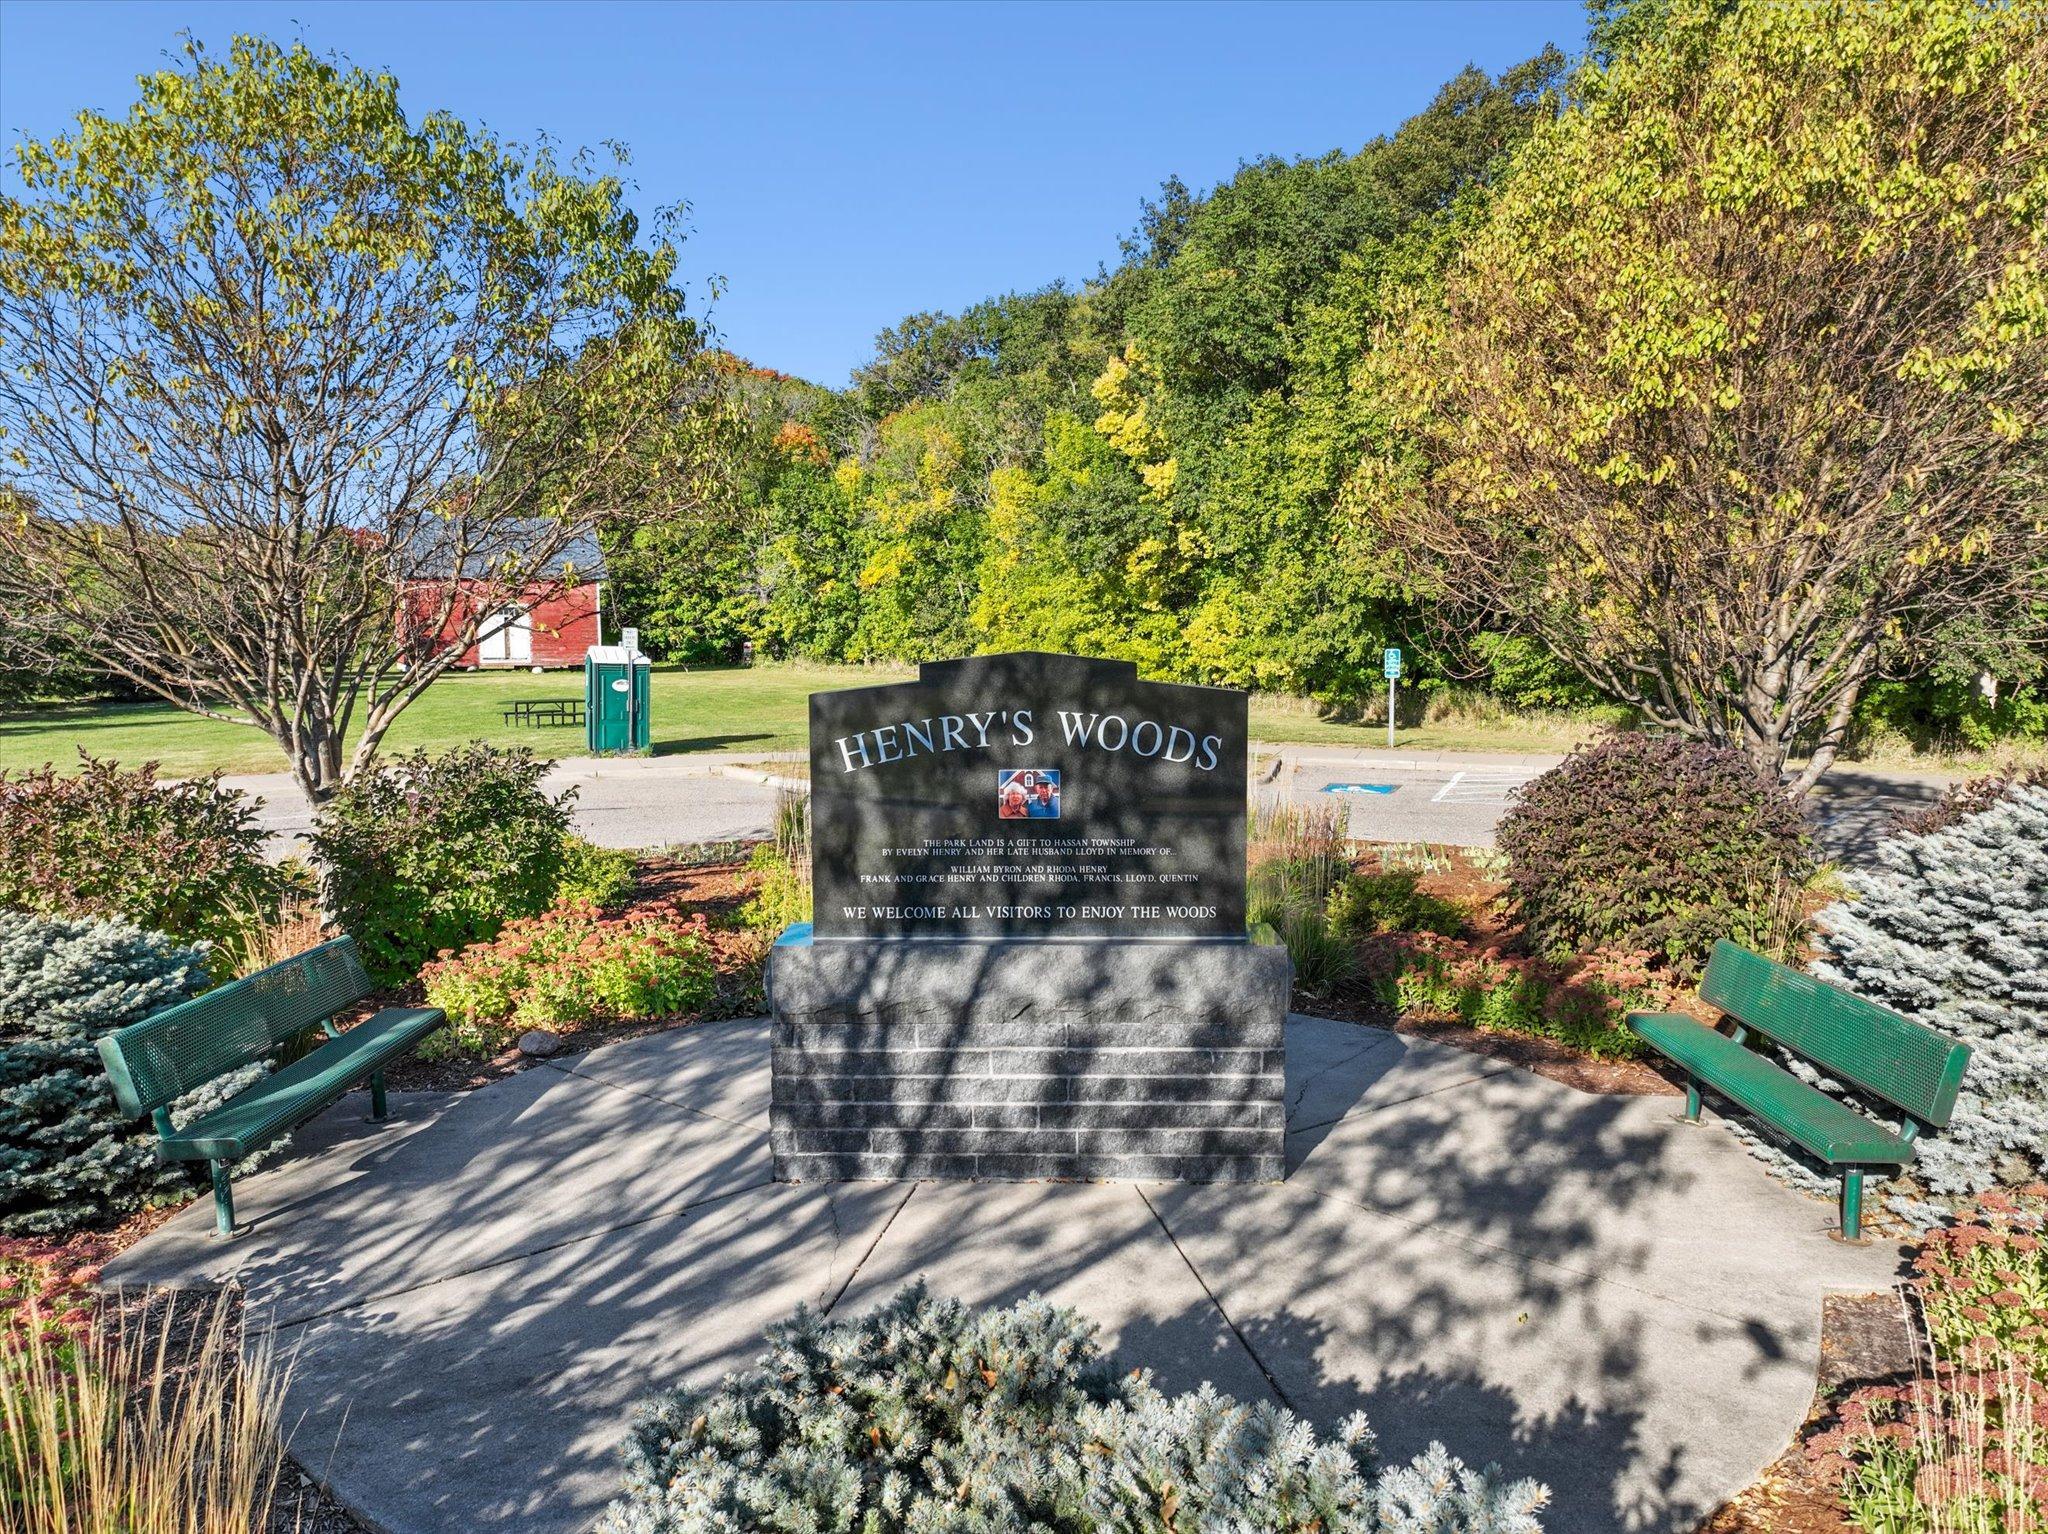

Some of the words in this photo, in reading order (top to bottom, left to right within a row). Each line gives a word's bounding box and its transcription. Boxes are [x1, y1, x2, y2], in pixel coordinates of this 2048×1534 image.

[835, 710, 1034, 774] HENRY'S
[1057, 711, 1222, 771] WOODS
[924, 839, 941, 847] THE
[944, 839, 966, 847] PARK
[969, 839, 994, 847] LAND
[997, 839, 1005, 847] IS
[1008, 839, 1014, 847] A
[1016, 839, 1036, 847] GIFT
[1040, 839, 1051, 847] TO
[1054, 839, 1088, 847] HASSAN
[1091, 839, 1136, 847] TOWNSHIP
[882, 848, 893, 856] BY
[896, 848, 929, 856] EVELYN
[933, 848, 962, 856] HENRY
[964, 848, 984, 856] AND
[987, 848, 1005, 856] HER
[1007, 848, 1029, 856] LATE
[1032, 848, 1073, 856] HUSBAND
[1076, 848, 1104, 856] LLOYD
[1107, 848, 1116, 856] IN
[1119, 848, 1157, 856] MEMORY
[951, 865, 990, 873] WILLIAM
[993, 865, 1022, 873] BYRON
[1025, 865, 1044, 873] AND
[1047, 865, 1076, 873] RHODA
[1079, 865, 1108, 873] HENRY
[860, 875, 891, 883] FRANK
[894, 875, 913, 883] AND
[916, 875, 944, 883] GRACE
[947, 875, 977, 883] HENRY
[979, 875, 999, 883] AND
[1001, 875, 1046, 883] CHILDREN
[1159, 875, 1199, 883] QUENTIN
[843, 906, 866, 918] WE
[872, 906, 946, 918] WELCOME
[952, 906, 980, 918] ALL
[986, 906, 1051, 918] VISITORS
[1057, 906, 1076, 918] TO
[1082, 906, 1125, 918] ENJOY
[1131, 906, 1160, 918] THE
[1166, 906, 1217, 918] WOODS
